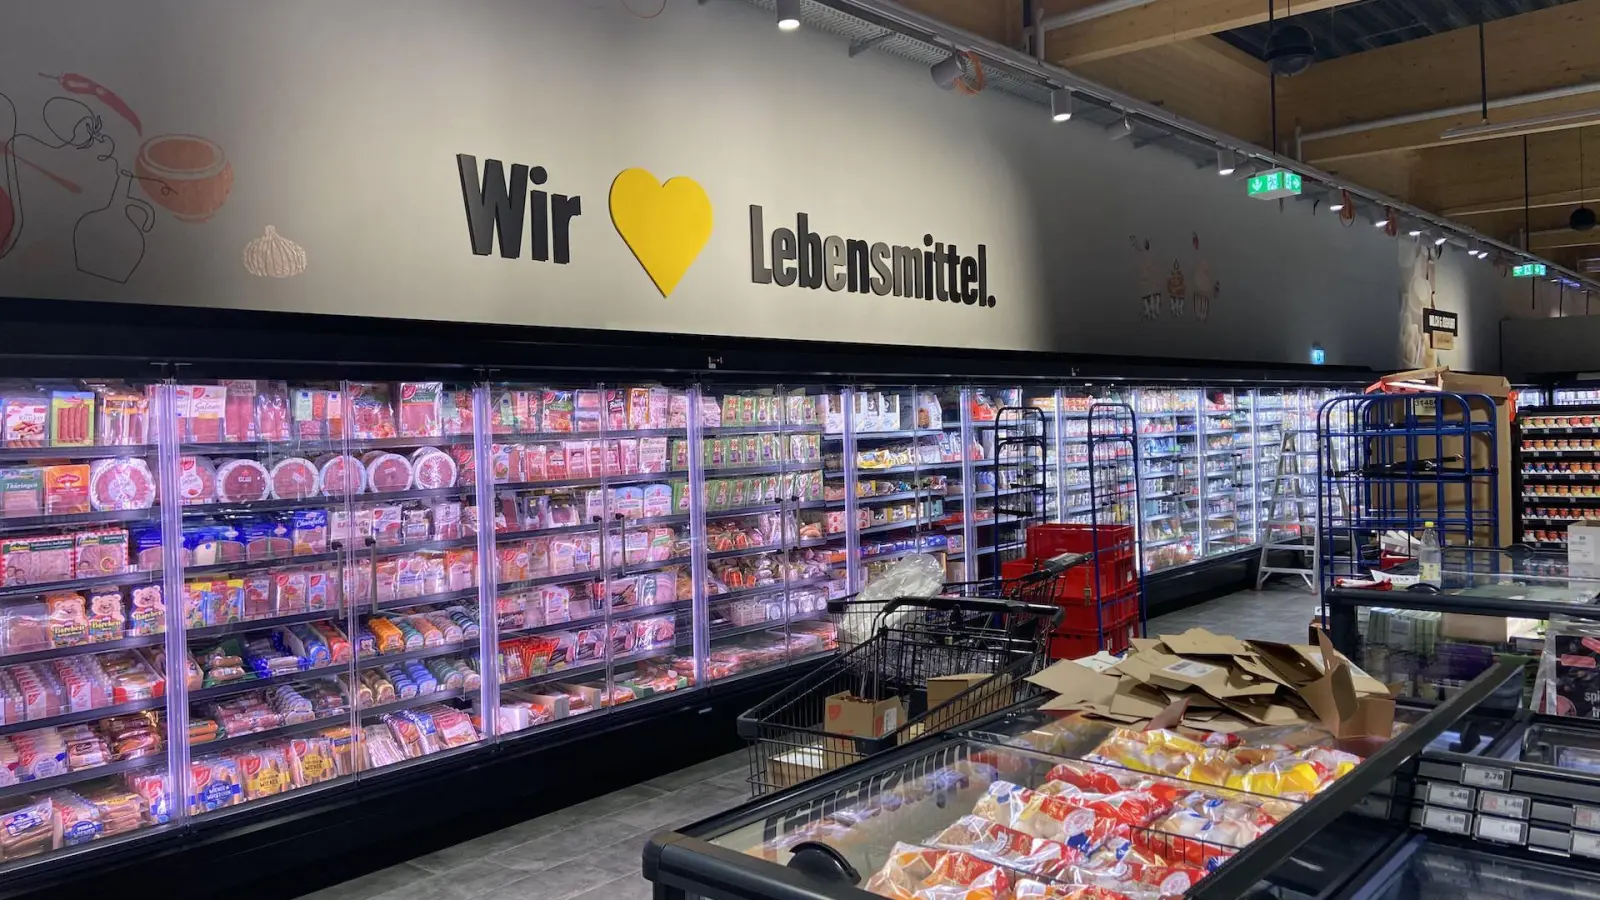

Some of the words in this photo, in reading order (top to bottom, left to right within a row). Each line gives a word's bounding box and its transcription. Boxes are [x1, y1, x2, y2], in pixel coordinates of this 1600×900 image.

[456, 153, 582, 265] Wir
[749, 204, 997, 308] Lebensmittel.
[1484, 772, 1503, 781] 2.79
